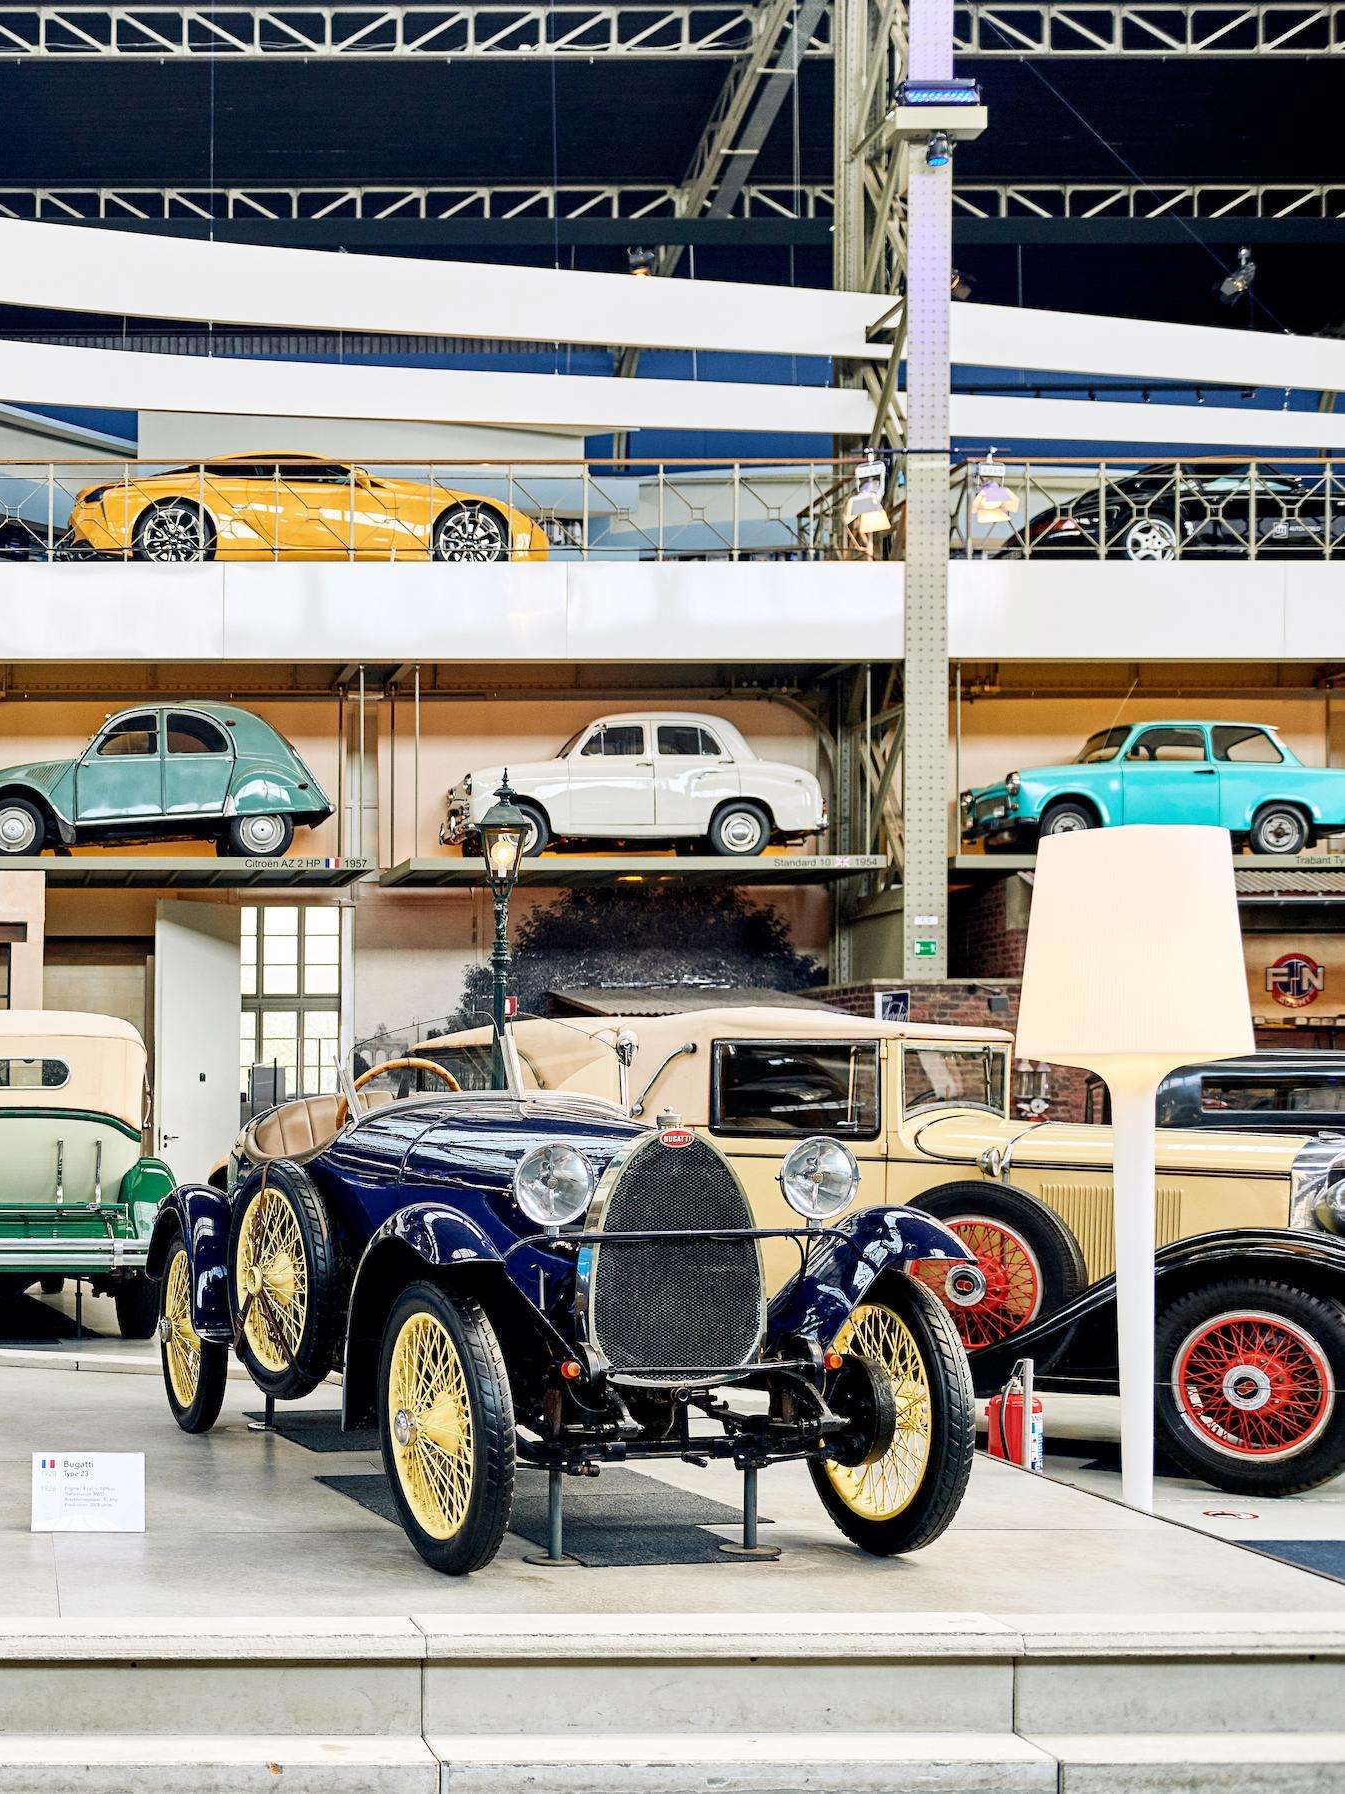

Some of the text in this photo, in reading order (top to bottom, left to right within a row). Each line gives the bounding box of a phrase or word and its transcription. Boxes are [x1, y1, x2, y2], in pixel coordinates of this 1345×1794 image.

[245, 859, 367, 868] Citroën AZ 2 HP 1957
[774, 857, 878, 867] Standard 10 1954
[1295, 855, 1331, 865] Trabant
[1266, 966, 1324, 991] FN
[63, 1460, 94, 1470] Bugatti
[63, 1470, 79, 1478] Type
